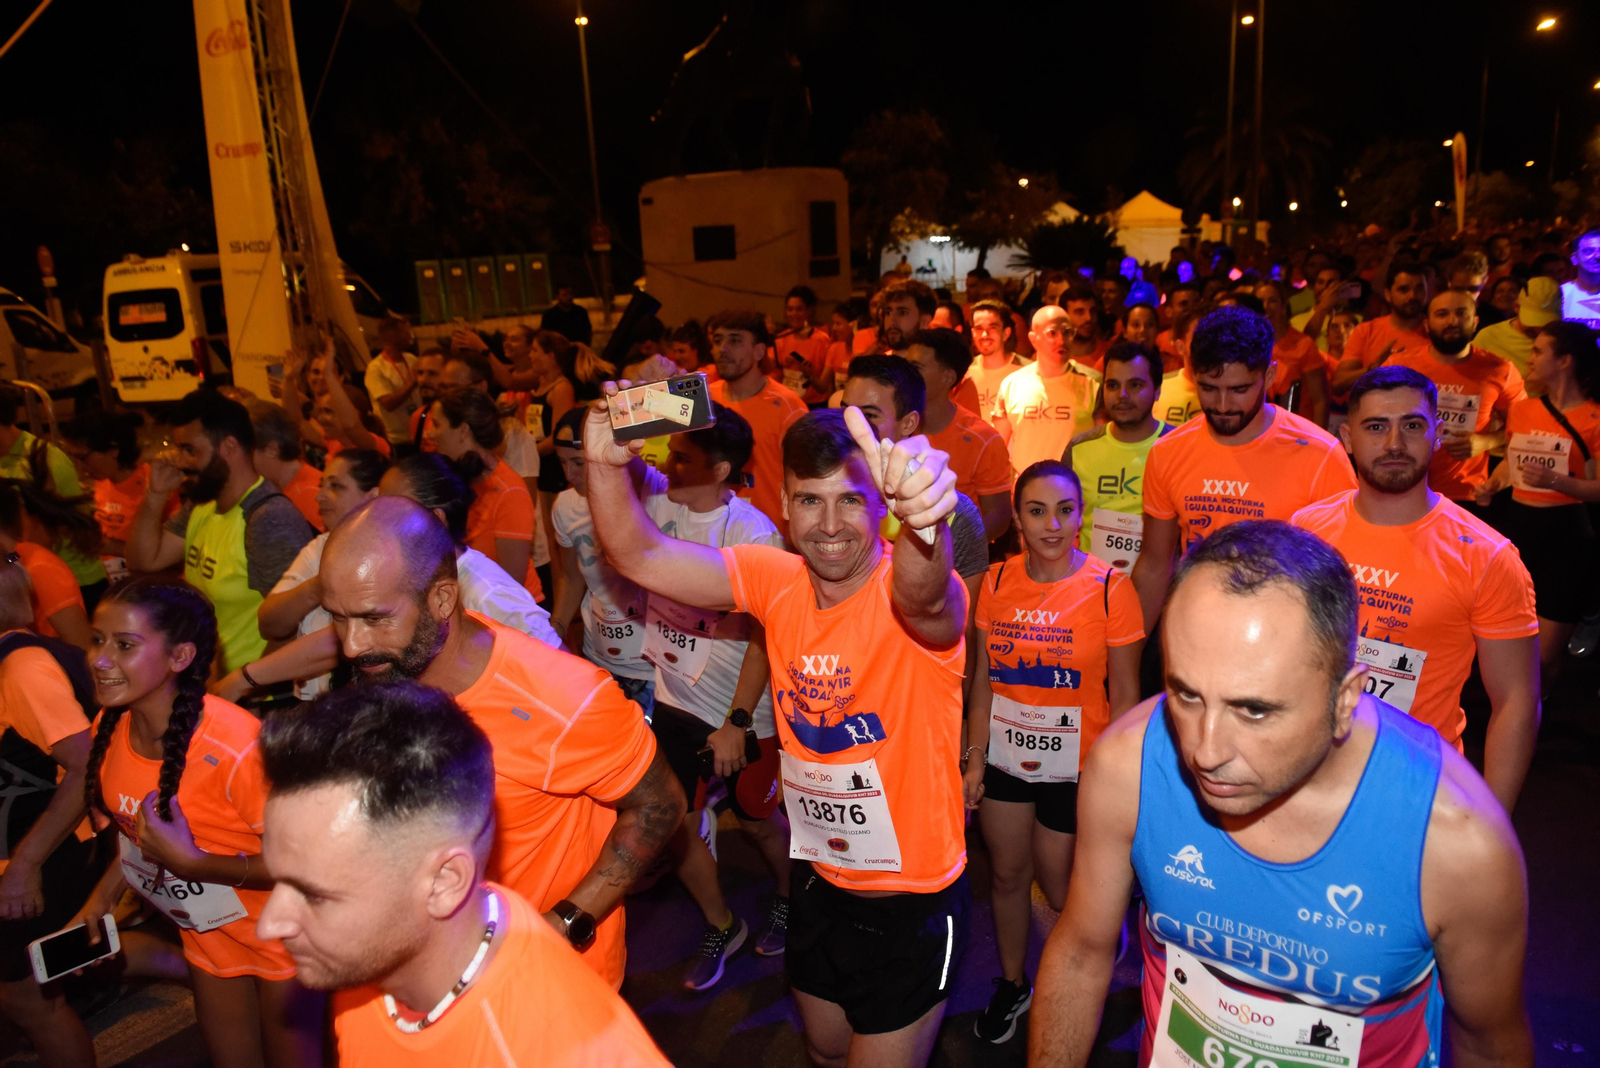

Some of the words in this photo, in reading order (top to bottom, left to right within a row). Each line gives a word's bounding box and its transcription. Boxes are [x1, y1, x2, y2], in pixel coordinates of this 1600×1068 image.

[1023, 401, 1071, 420] eks
[1202, 478, 1250, 497] XXXV
[1184, 495, 1218, 503] CARRERA
[1221, 497, 1265, 508] NOCTURNA
[1188, 503, 1265, 518] GUADALQUIVIR
[1105, 534, 1143, 553] 5689
[1359, 586, 1414, 605] NOCTURNA
[1358, 595, 1412, 616] LQUIVIR
[1012, 608, 1060, 625] XXXV
[596, 622, 634, 639] 18383
[656, 620, 697, 652] 18381
[991, 620, 1026, 632] CARRERA
[1029, 625, 1074, 635] NOCTURNA
[994, 628, 1074, 644] GUADALQUIVIR
[989, 642, 1010, 653] KH7
[1005, 728, 1062, 751] 19858
[798, 796, 866, 825] 13876
[864, 857, 896, 866] Cruzcampo
[1164, 864, 1217, 890] austral
[1196, 911, 1235, 935] CLUB
[1238, 922, 1328, 965] DEPORTIVO
[1152, 911, 1381, 1005] CREDUS
[1204, 1017, 1241, 1042] NOCTURNA
[1240, 1037, 1254, 1046] DEL
[1253, 1042, 1309, 1058] GUADALQUIVIR
[1325, 1053, 1345, 1065] 2023
[1203, 1036, 1279, 1068] 67
